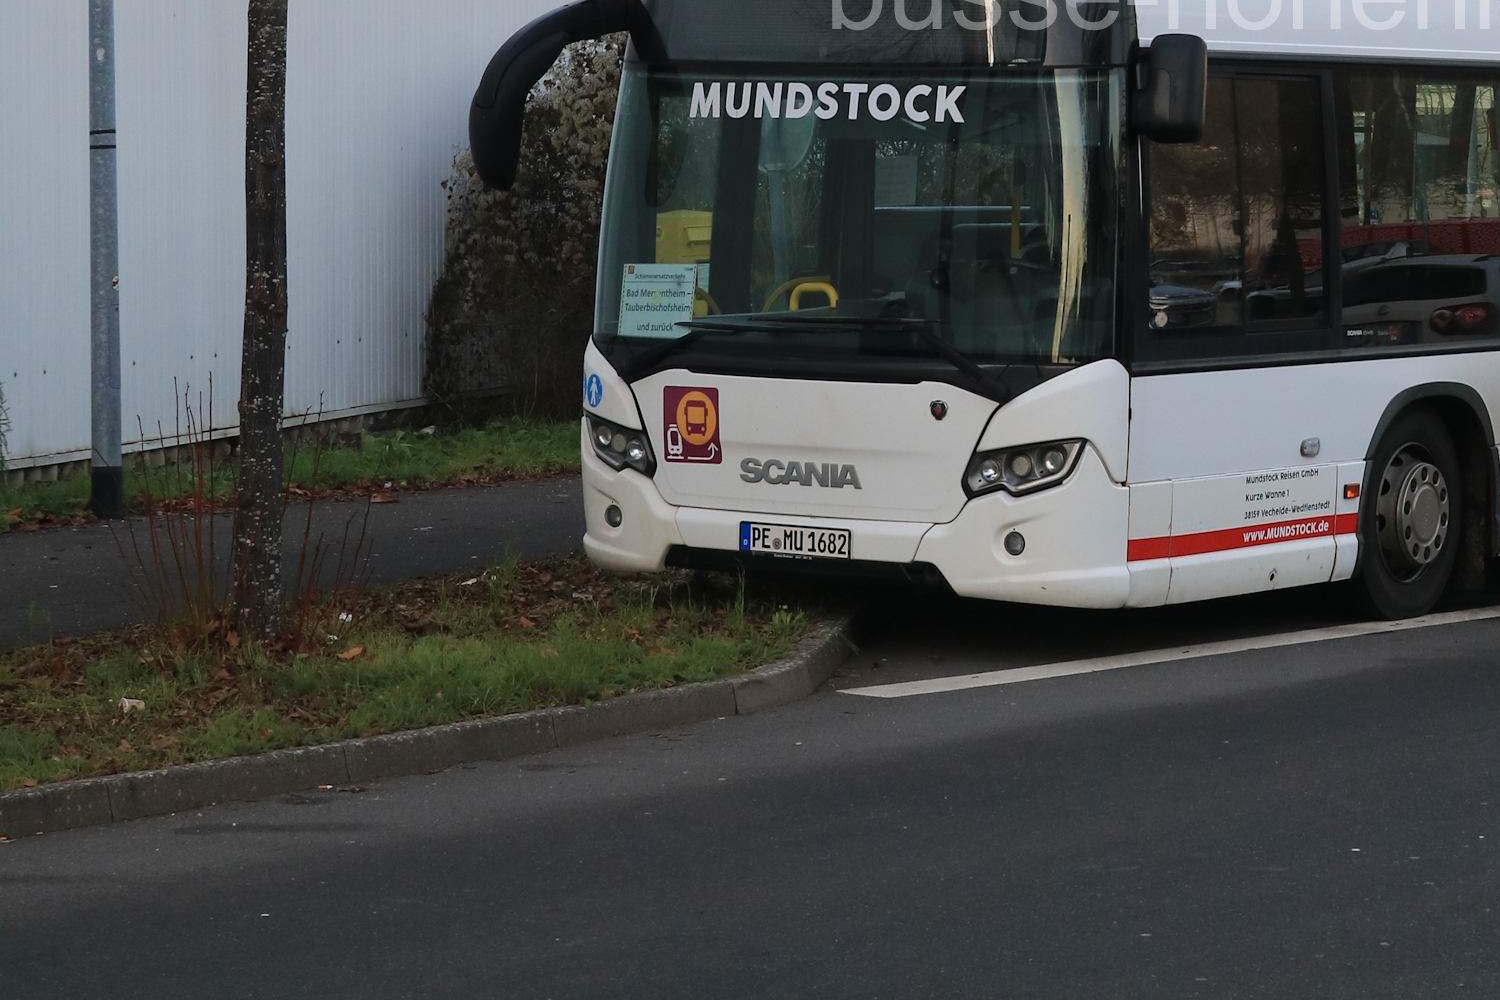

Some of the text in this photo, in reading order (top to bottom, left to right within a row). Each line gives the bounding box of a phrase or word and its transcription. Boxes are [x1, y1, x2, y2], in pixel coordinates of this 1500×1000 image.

[689, 82, 967, 123] MUNDSTOCK
[626, 289, 639, 298] Bad
[640, 289, 686, 298] Merntheim
[625, 303, 691, 312] Tauberbischofsheim
[636, 323, 673, 331] und zurück
[740, 457, 862, 490] SCANIA
[1246, 468, 1319, 484] Mundstock Reisen GmbH
[1245, 491, 1264, 502] Kurze
[1264, 489, 1286, 500] Wanne
[1244, 511, 1260, 519] 38159
[1243, 520, 1330, 543] www.MUNDSTOCK.de
[752, 526, 771, 549] PE
[783, 529, 804, 551] MU
[808, 531, 847, 555] 1682
